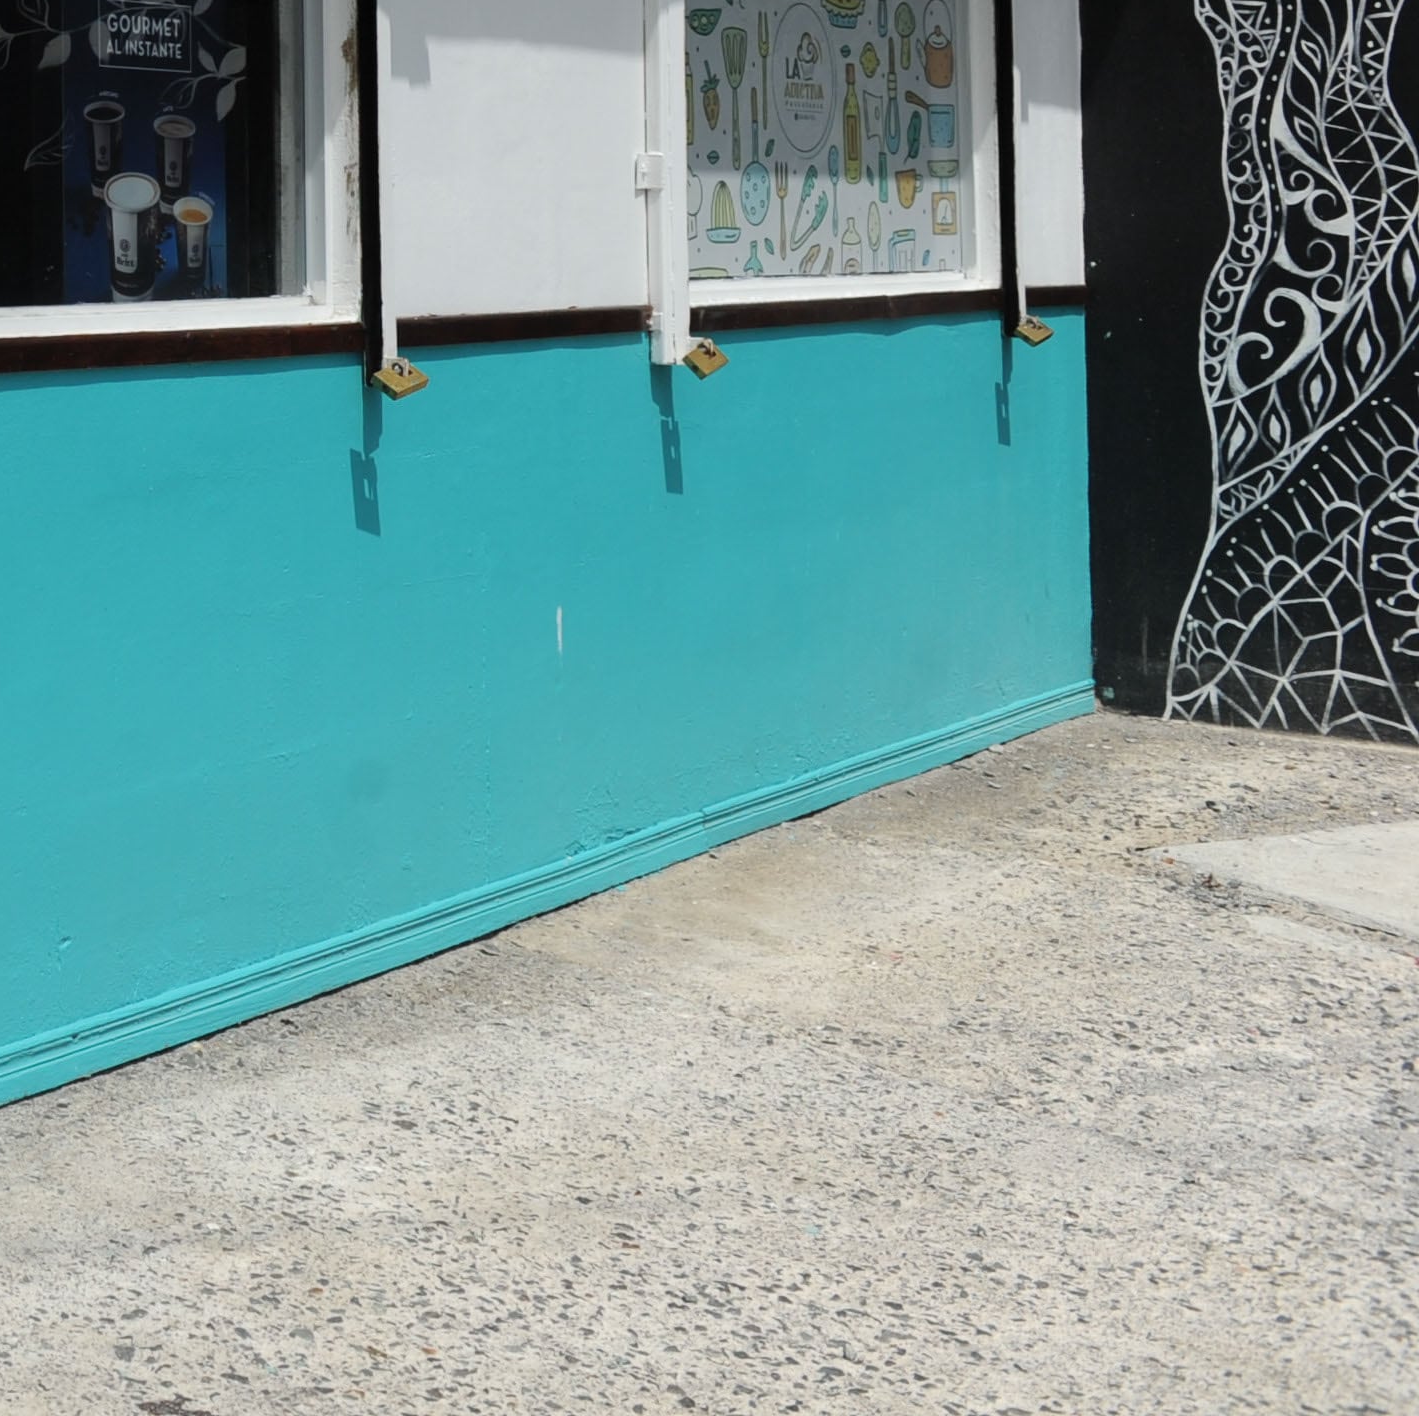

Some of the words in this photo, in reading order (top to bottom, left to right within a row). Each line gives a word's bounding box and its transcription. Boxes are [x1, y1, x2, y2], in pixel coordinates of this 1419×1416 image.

[106, 13, 181, 38] GOURMET
[106, 39, 121, 56] AL
[125, 39, 183, 60] INSTANTE
[786, 56, 801, 80] LA
